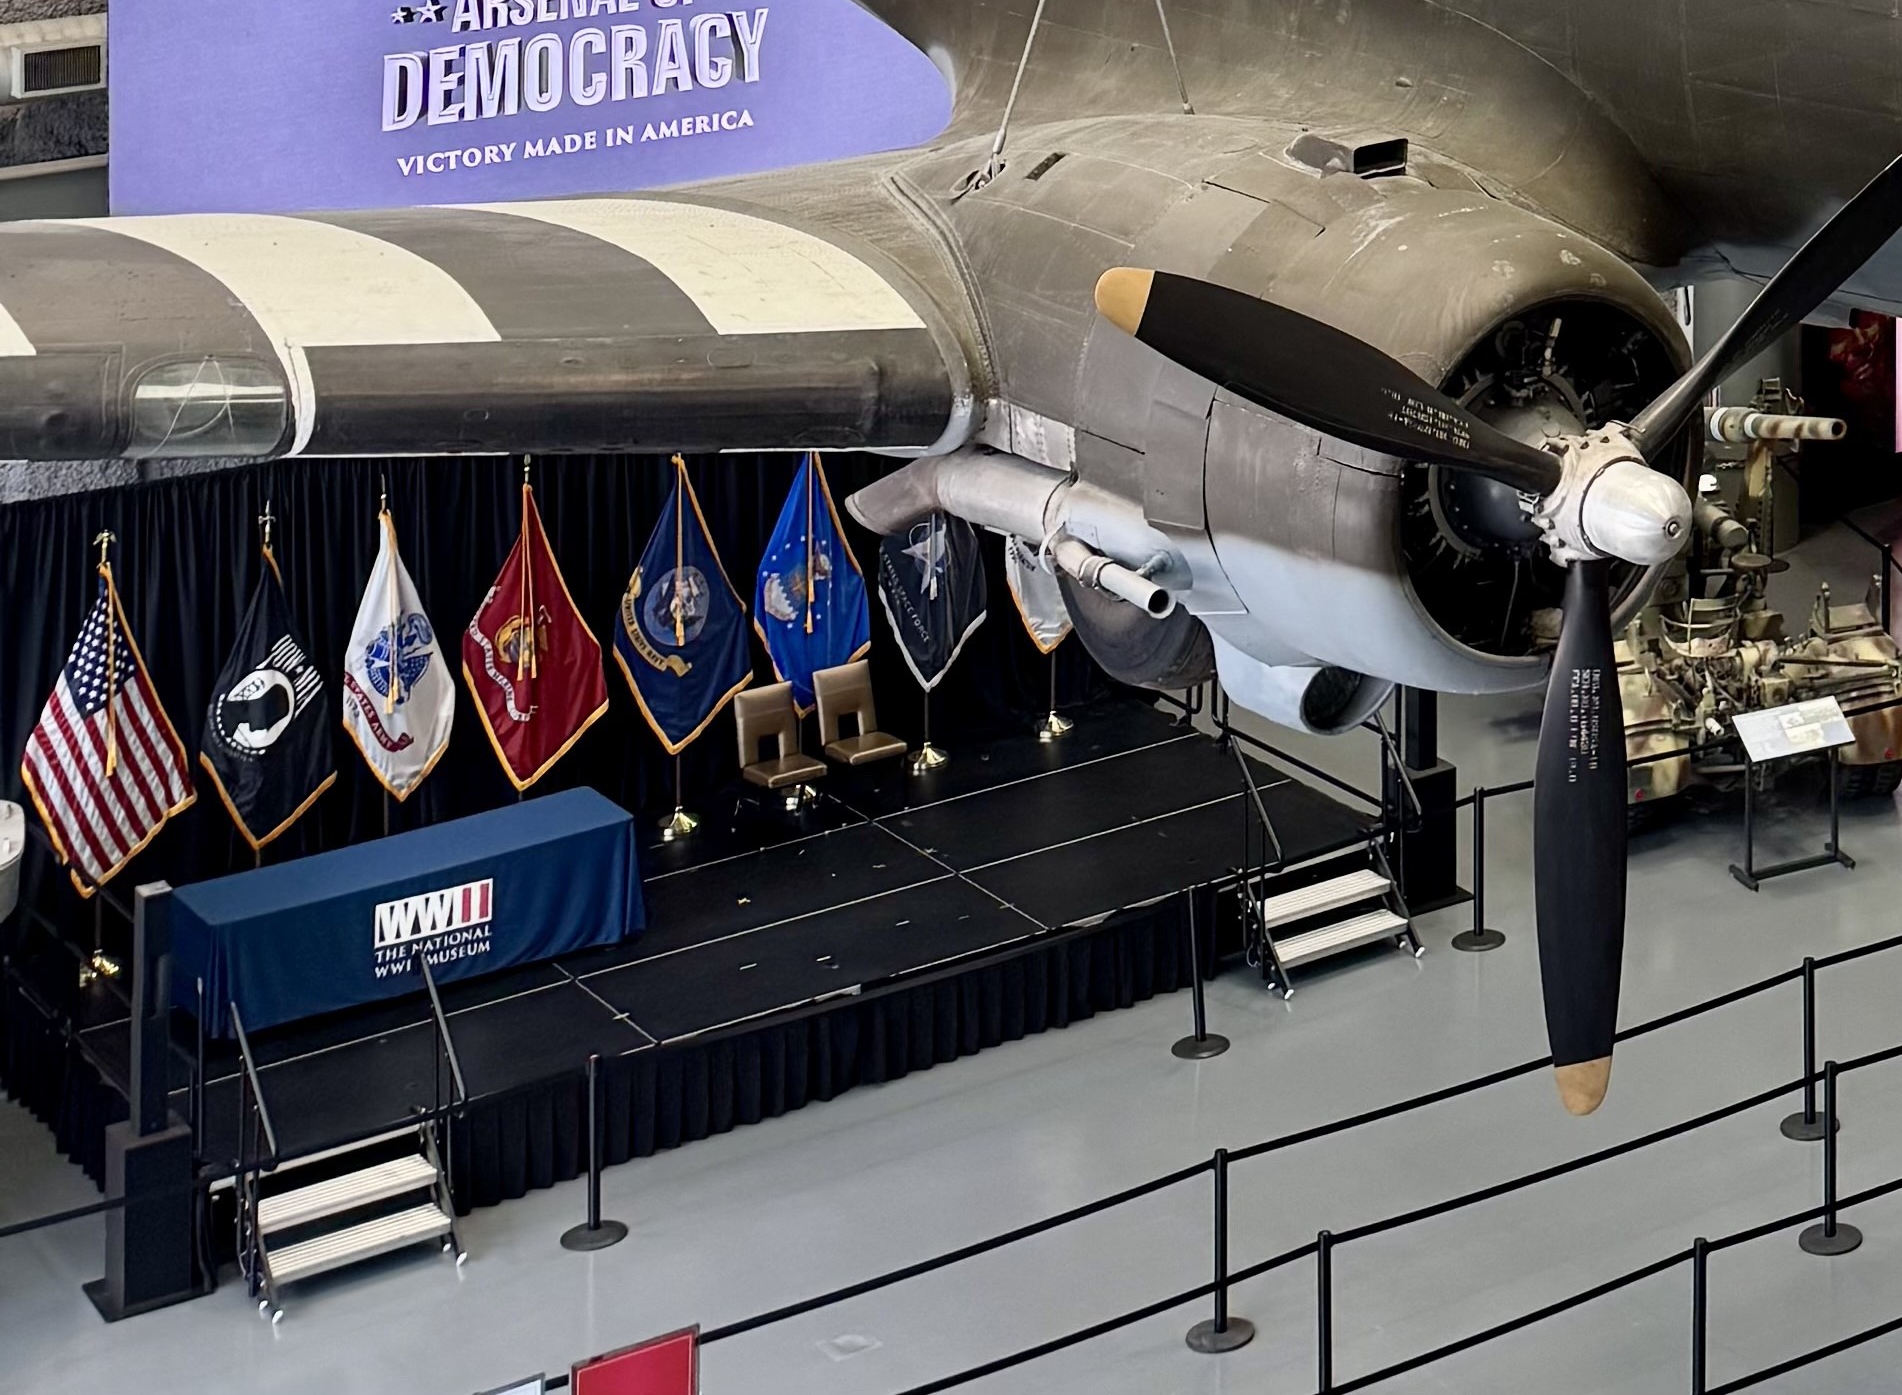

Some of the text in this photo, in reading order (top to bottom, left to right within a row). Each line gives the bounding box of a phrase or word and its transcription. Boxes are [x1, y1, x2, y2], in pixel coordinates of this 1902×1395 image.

[381, 7, 769, 132] DEMOCRACY
[397, 109, 754, 177] VICTORY MADE IN AMERICA
[375, 924, 493, 964] THE NATIONAL
[377, 881, 491, 945] WWII
[374, 941, 491, 980] WWI MUSEUM
